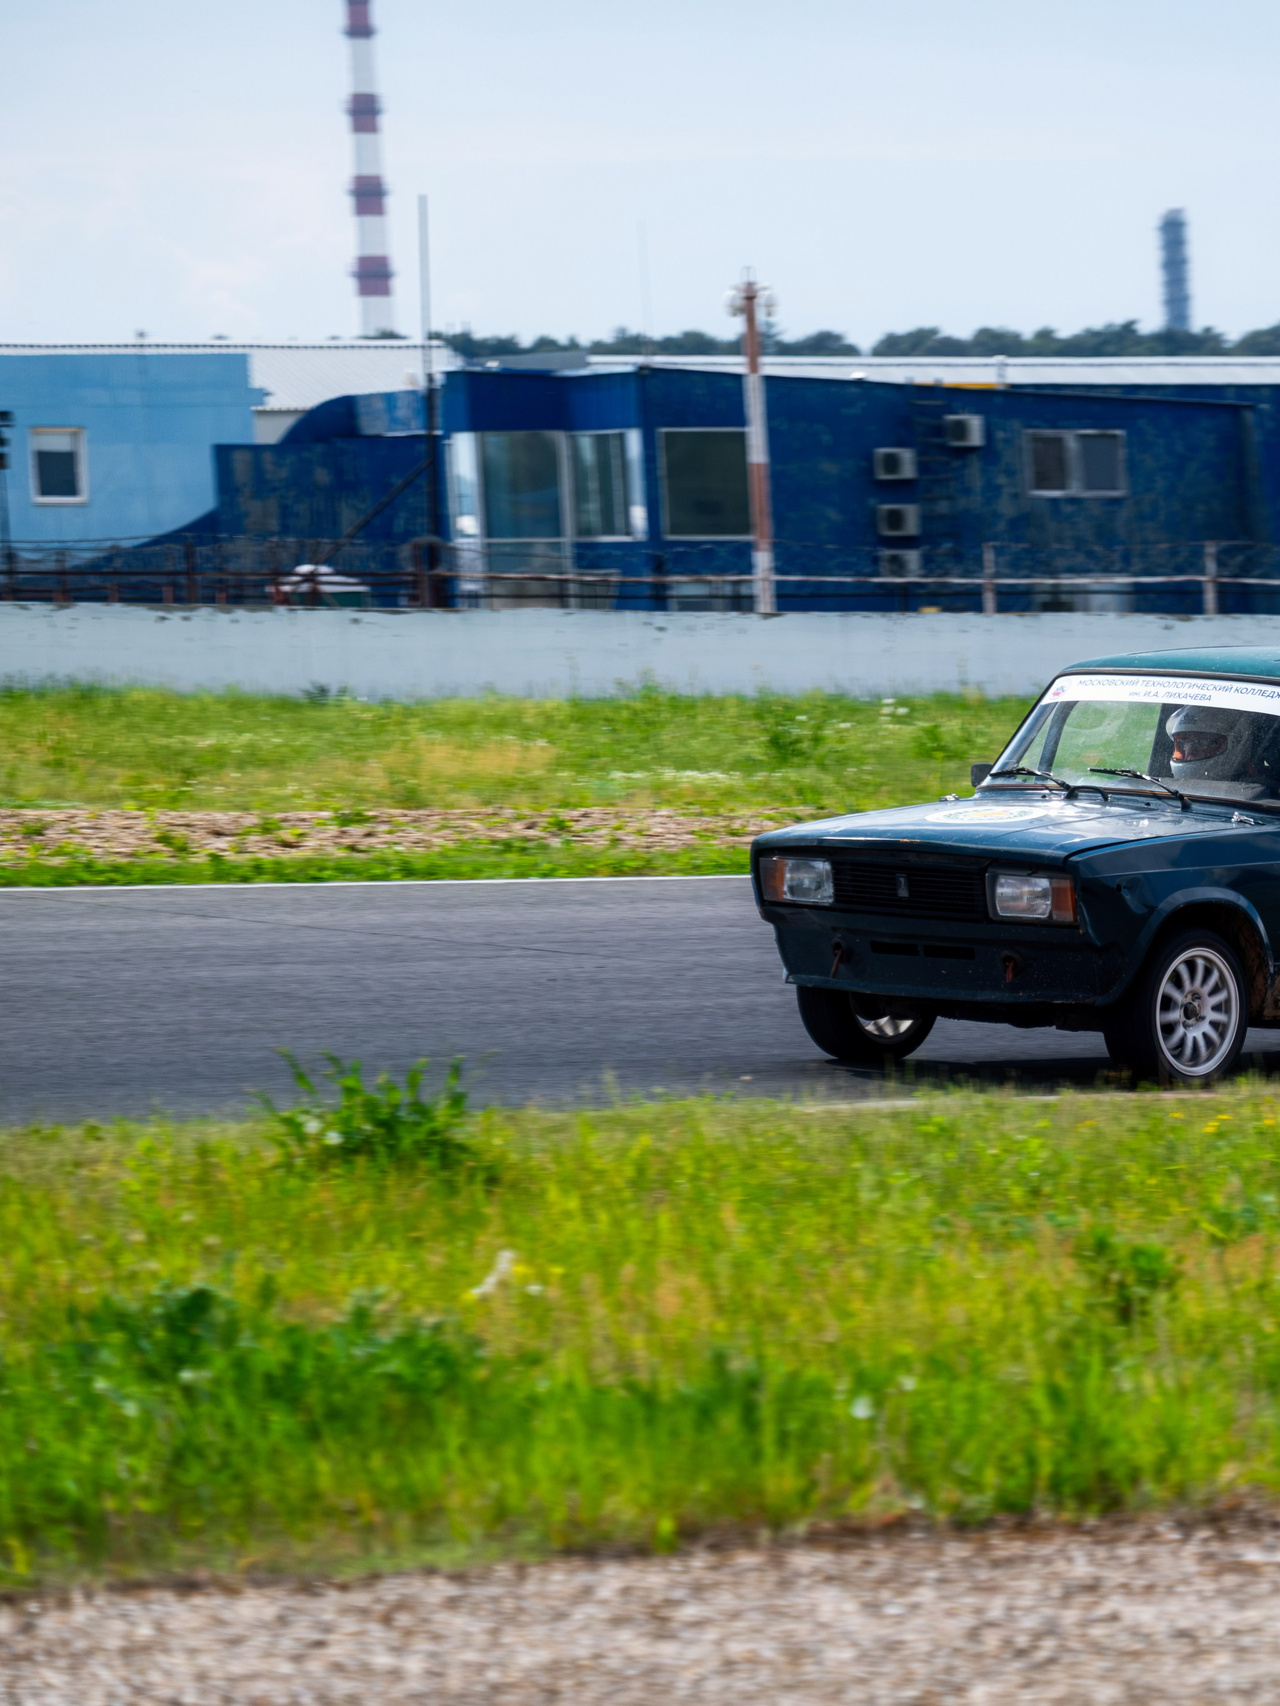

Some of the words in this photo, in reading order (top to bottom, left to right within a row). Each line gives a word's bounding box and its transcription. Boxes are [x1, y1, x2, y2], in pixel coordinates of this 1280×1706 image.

[1077, 678, 1139, 687] МОСКОВСКИЙ
[1140, 679, 1233, 692] ТЕХНОЛОГИЧЕСКИЙ
[1162, 691, 1212, 702] ЛИХАЧЕВА
